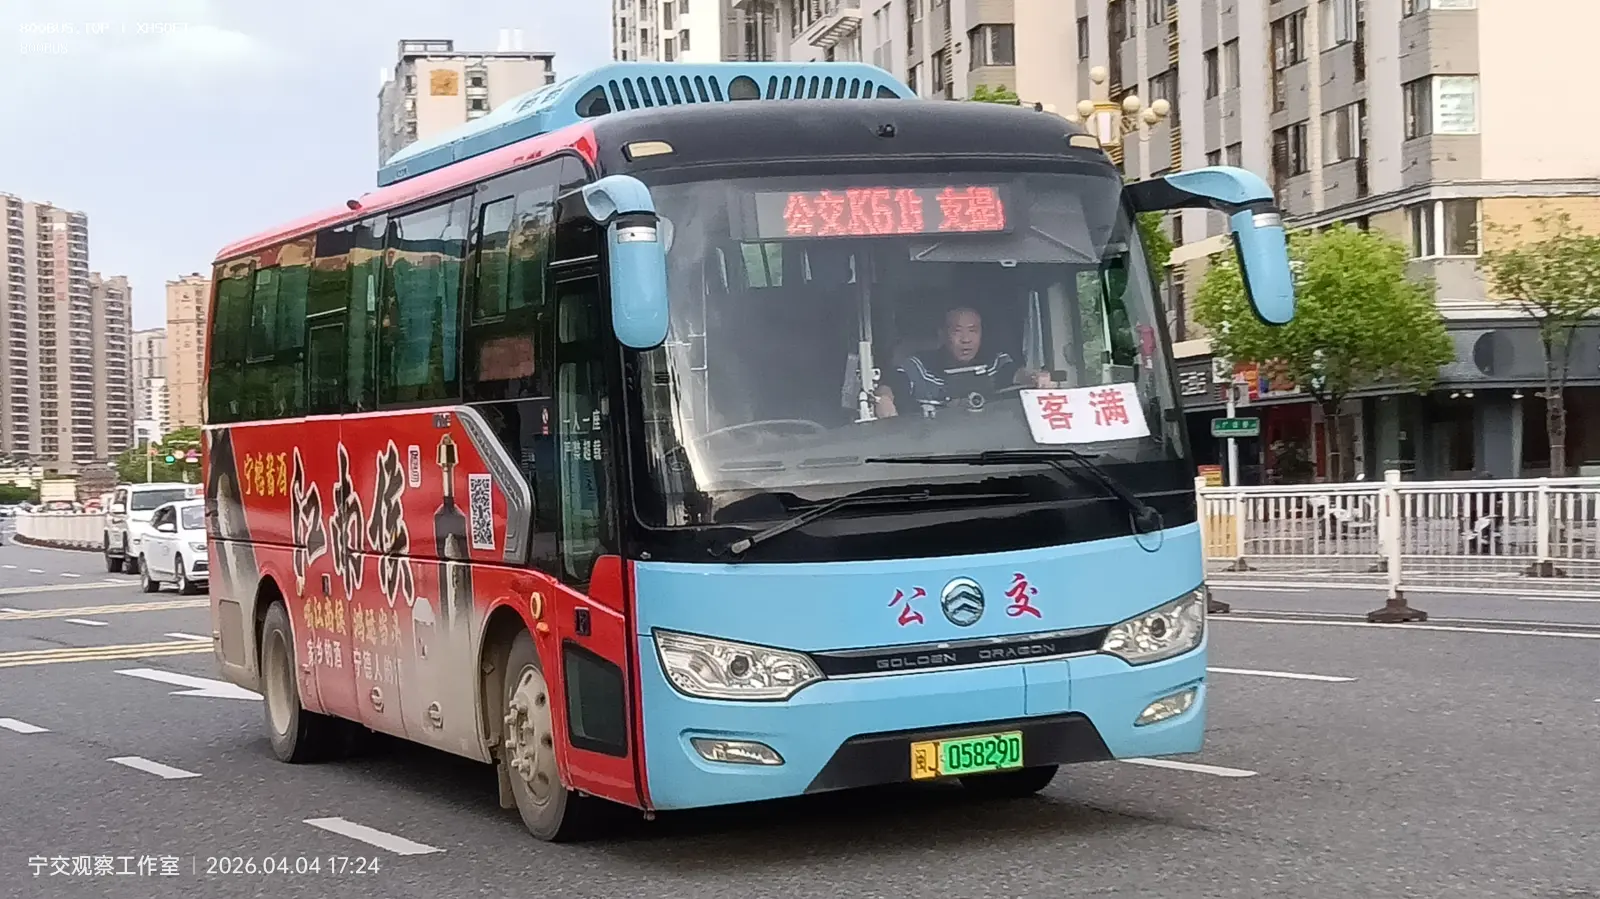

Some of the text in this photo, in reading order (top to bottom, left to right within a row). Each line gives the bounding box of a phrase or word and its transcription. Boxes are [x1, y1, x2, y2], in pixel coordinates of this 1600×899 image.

[1037, 388, 1129, 430] 客满
[887, 572, 1042, 626] 公 交
[876, 643, 1056, 669] GOLDEN DRAGON
